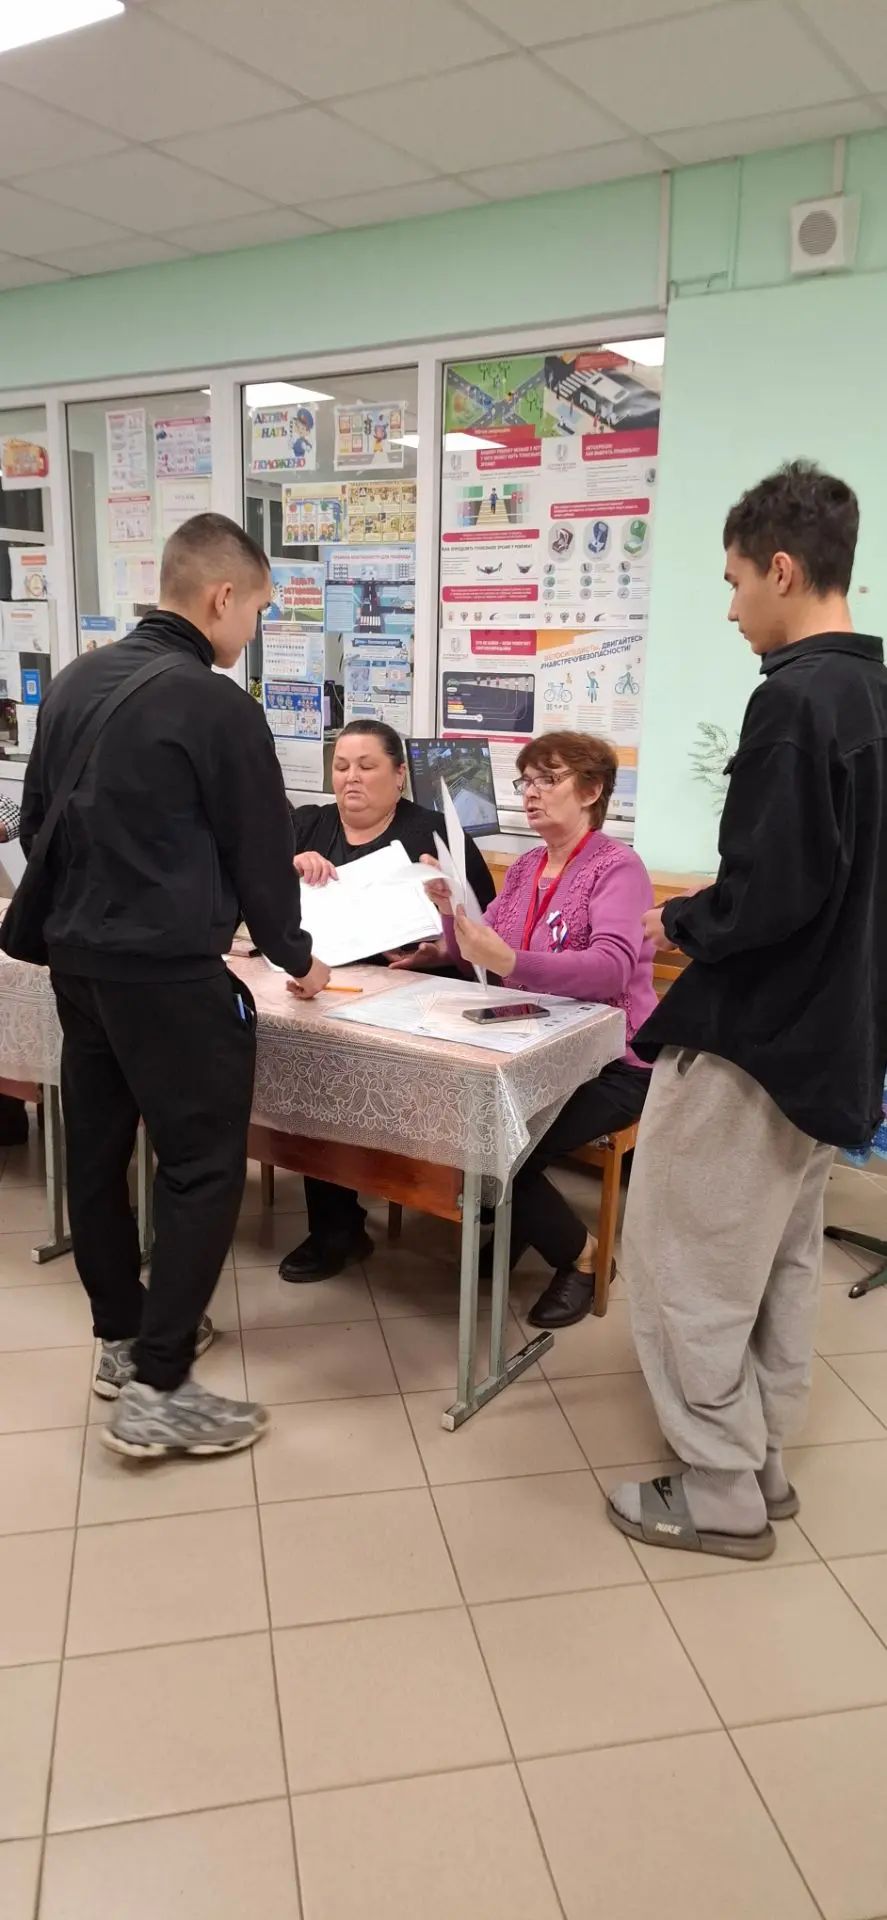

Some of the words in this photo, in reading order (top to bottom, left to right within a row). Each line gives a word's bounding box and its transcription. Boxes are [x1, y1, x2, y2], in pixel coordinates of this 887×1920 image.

[254, 411, 288, 424] ДЕТЯМ
[255, 427, 288, 439] ЗНАТЬ
[253, 457, 305, 470] ПОЛОЖЕНО
[601, 635, 643, 650] ДВИГАЙТЕСЬ
[655, 1521, 682, 1536] NIKE
